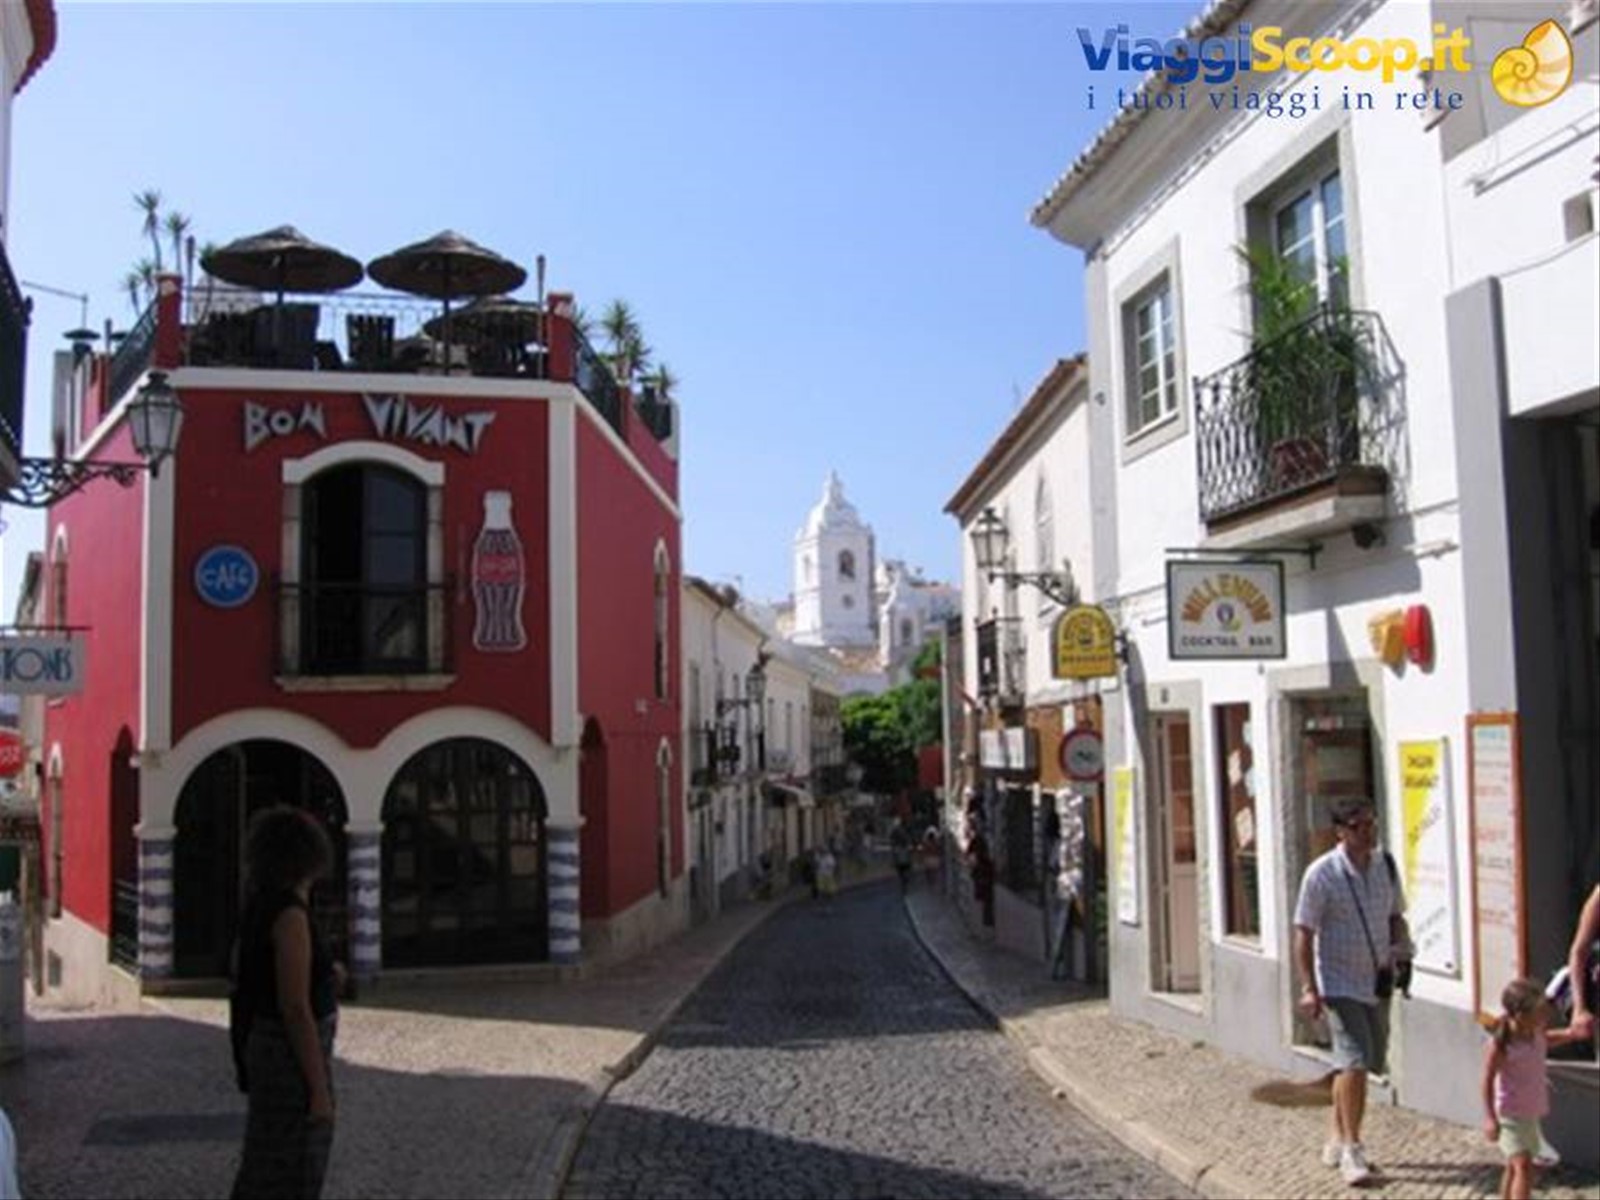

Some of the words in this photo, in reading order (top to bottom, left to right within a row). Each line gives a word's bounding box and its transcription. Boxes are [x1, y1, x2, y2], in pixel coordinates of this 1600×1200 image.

[362, 394, 496, 453] VIVANT
[1181, 636, 1238, 647] COCKTAIL
[0, 648, 73, 682] TONES
